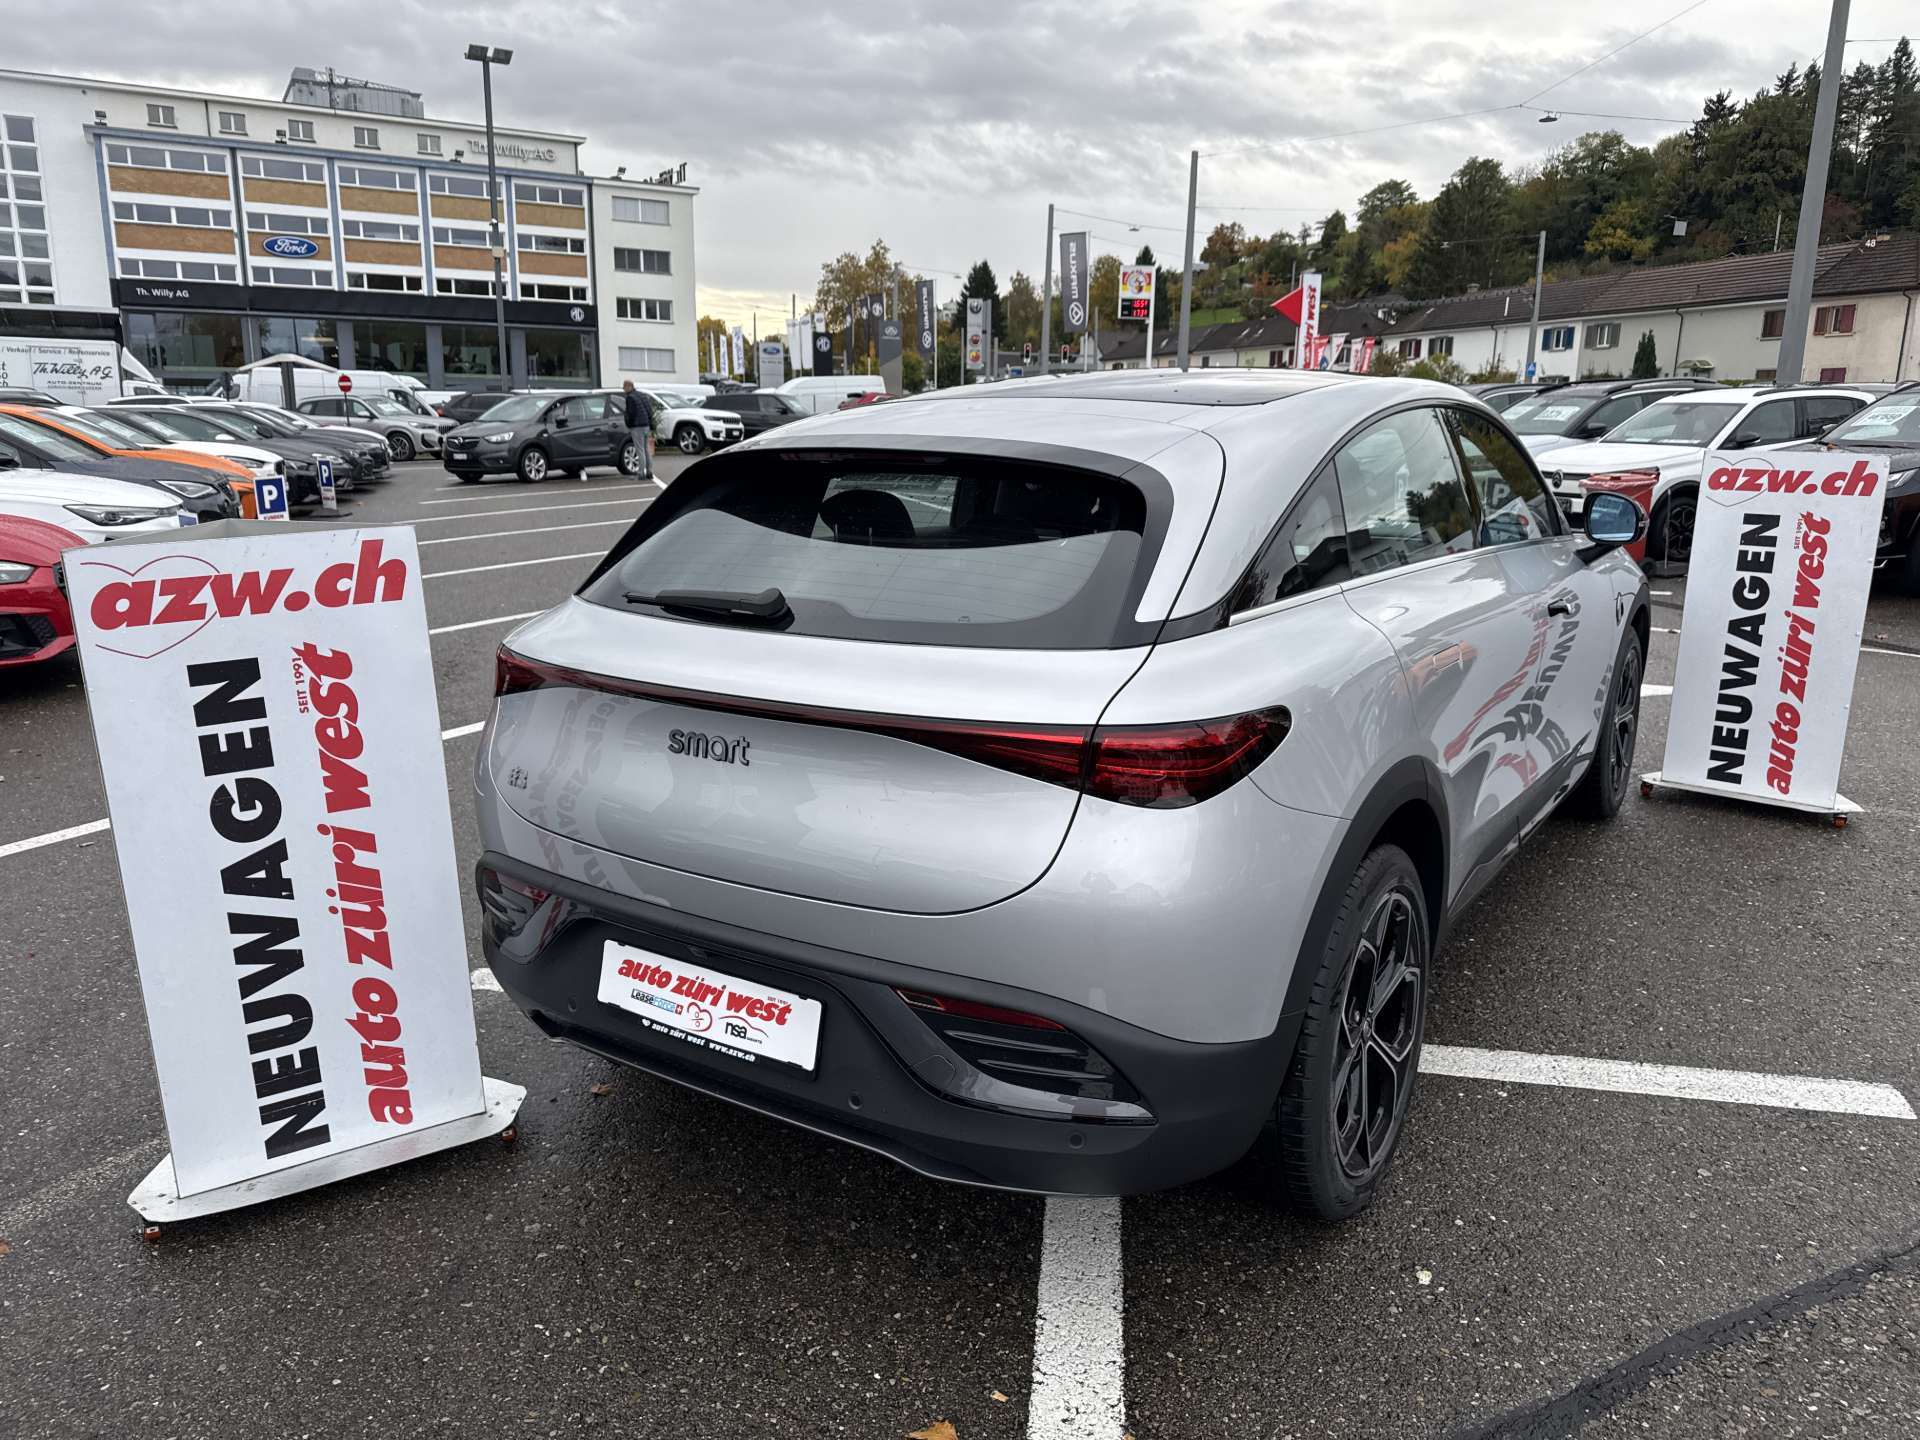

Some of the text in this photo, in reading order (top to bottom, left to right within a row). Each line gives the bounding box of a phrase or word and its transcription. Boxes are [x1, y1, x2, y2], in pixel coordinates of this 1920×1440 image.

[496, 143, 530, 162] Willy
[534, 147, 558, 162] AG
[135, 287, 190, 299] Th. Willy AG
[50, 362, 89, 379] Willy
[90, 365, 113, 380] AG
[322, 464, 329, 484] P
[1708, 460, 1879, 497] azw.ch
[262, 484, 278, 510] P
[1793, 536, 1801, 550] SEIT
[91, 539, 407, 631] azw.ch
[1706, 513, 1781, 785] NEUWAGEN
[1766, 511, 1832, 795] auto züri west
[294, 656, 310, 714] SEIT 1991
[667, 729, 751, 766] smart
[291, 641, 413, 1126] auto züri west
[187, 657, 331, 1160] NEUWAGEN
[617, 958, 793, 1026] auto züri west
[651, 1022, 756, 1063] auto züri west www.azw.ch
[725, 1021, 748, 1040] nsa
